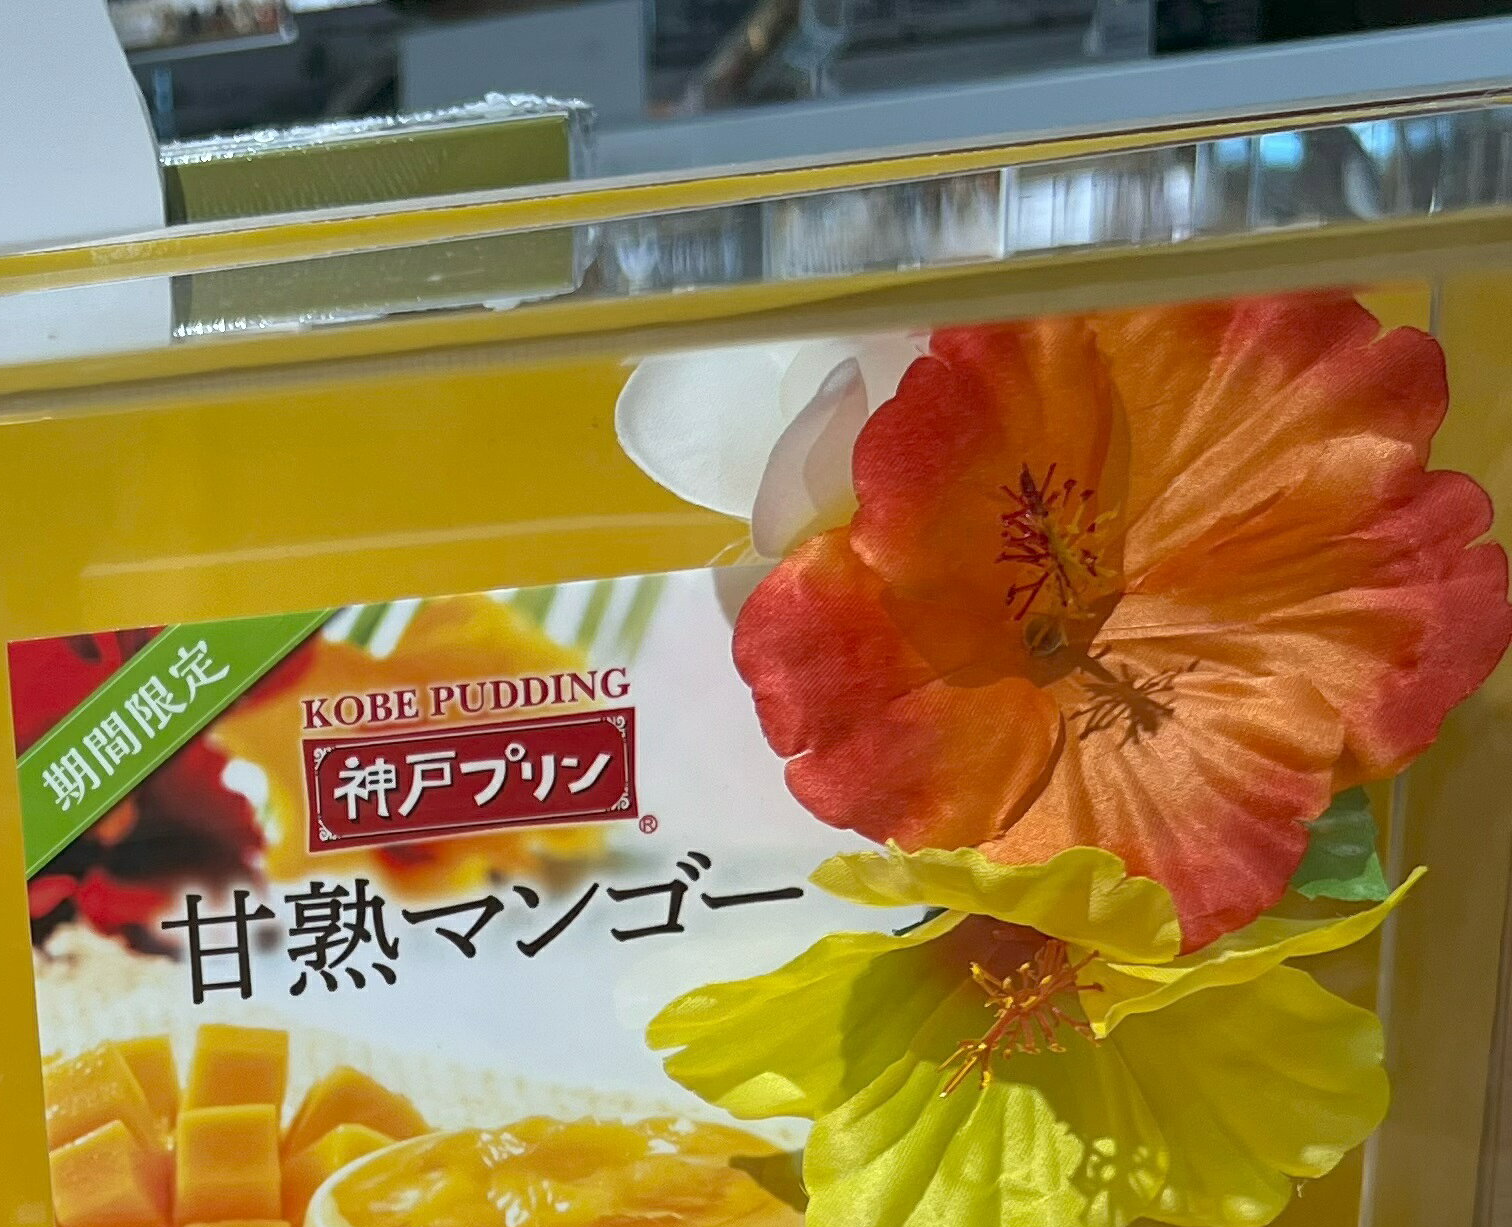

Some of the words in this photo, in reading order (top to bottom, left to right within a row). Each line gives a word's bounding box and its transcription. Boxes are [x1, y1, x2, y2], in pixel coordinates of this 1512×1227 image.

[42, 636, 232, 812] 期間限定
[301, 684, 419, 731] KOBE
[430, 666, 631, 718] PUDDING
[333, 742, 614, 821] 神戸プリン
[161, 850, 805, 1006] 甘熟マンゴー
